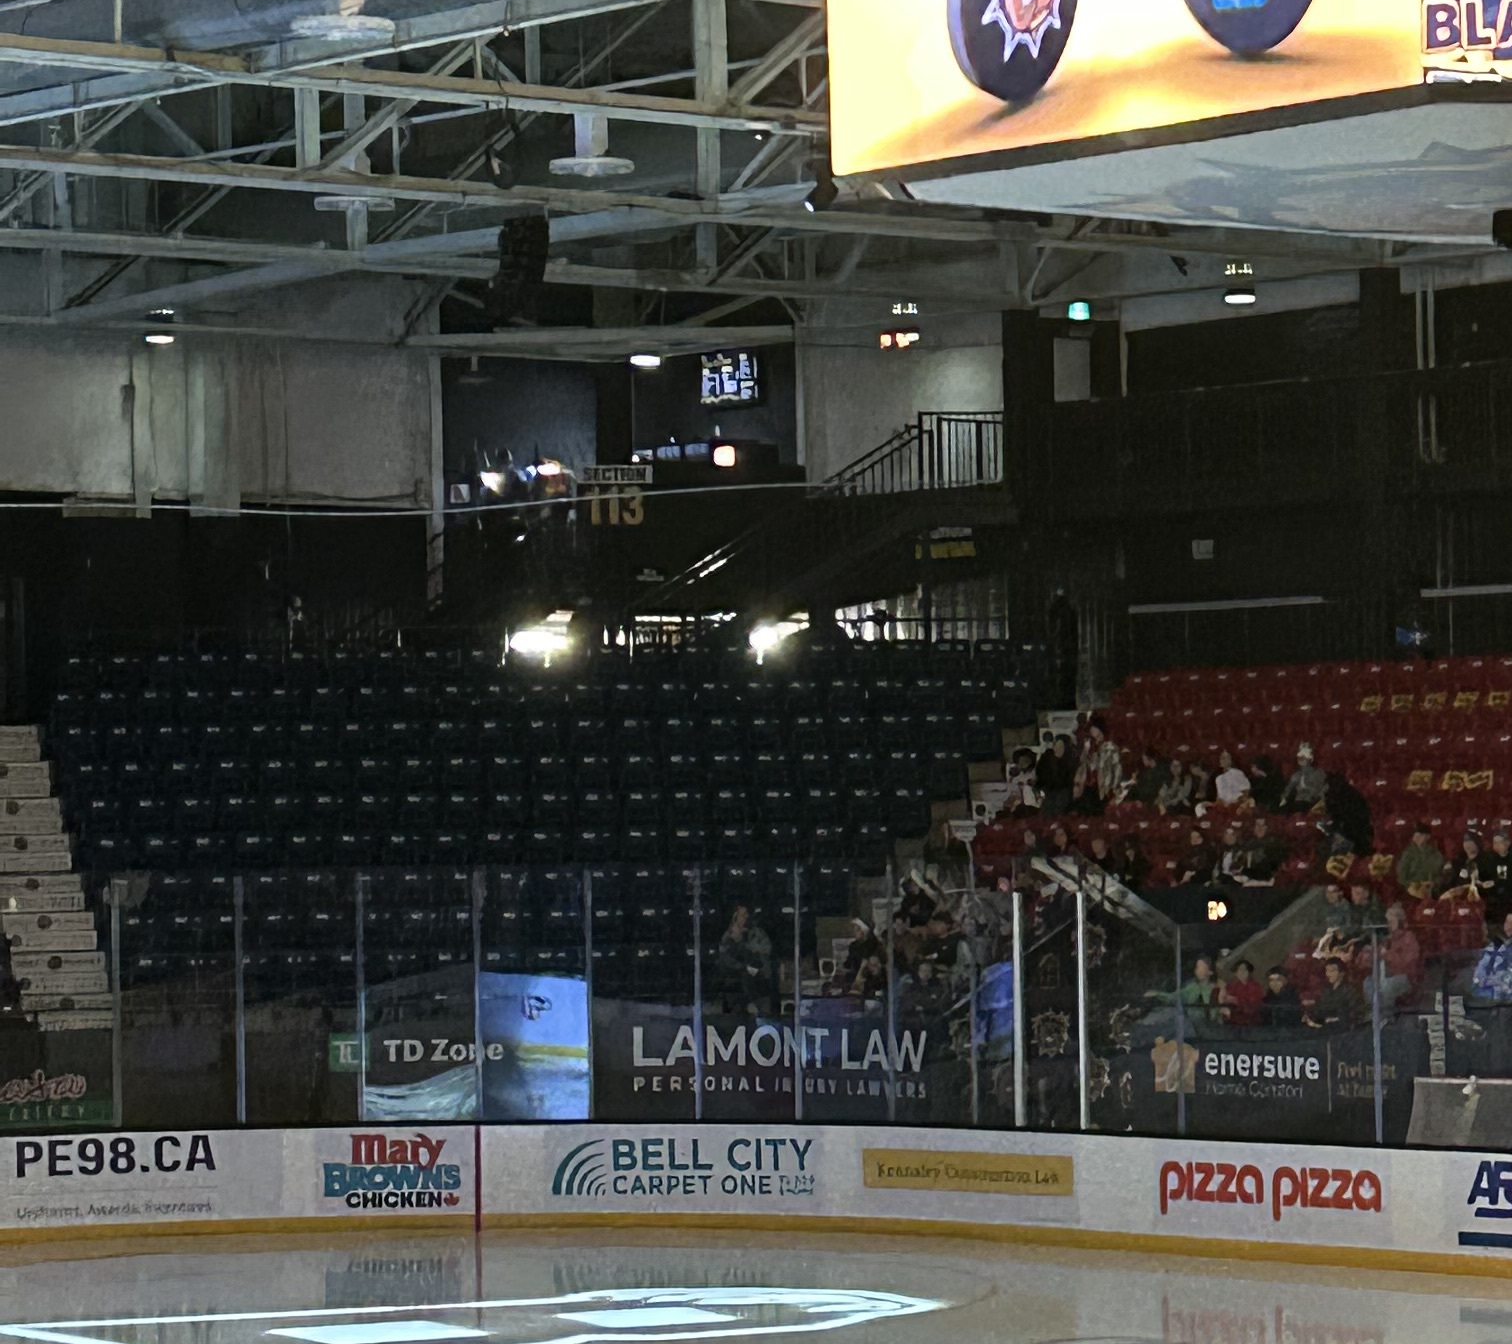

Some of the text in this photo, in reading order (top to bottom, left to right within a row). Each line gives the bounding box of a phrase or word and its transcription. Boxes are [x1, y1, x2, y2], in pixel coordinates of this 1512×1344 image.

[586, 486, 644, 525] 113
[383, 1039, 504, 1062] TD Zone
[632, 1025, 927, 1073] LAMONT LAW
[1204, 1052, 1320, 1080] enersure
[633, 1076, 765, 1093] PERSONAL
[15, 1134, 216, 1179] PE98.CA
[350, 1133, 447, 1169] Mary
[612, 1137, 812, 1172] BELL CITY
[345, 1191, 443, 1209] CHICKEN
[613, 1174, 709, 1196] CARPET
[721, 1174, 772, 1196] ONE
[1160, 1160, 1383, 1222] pizza pizza
